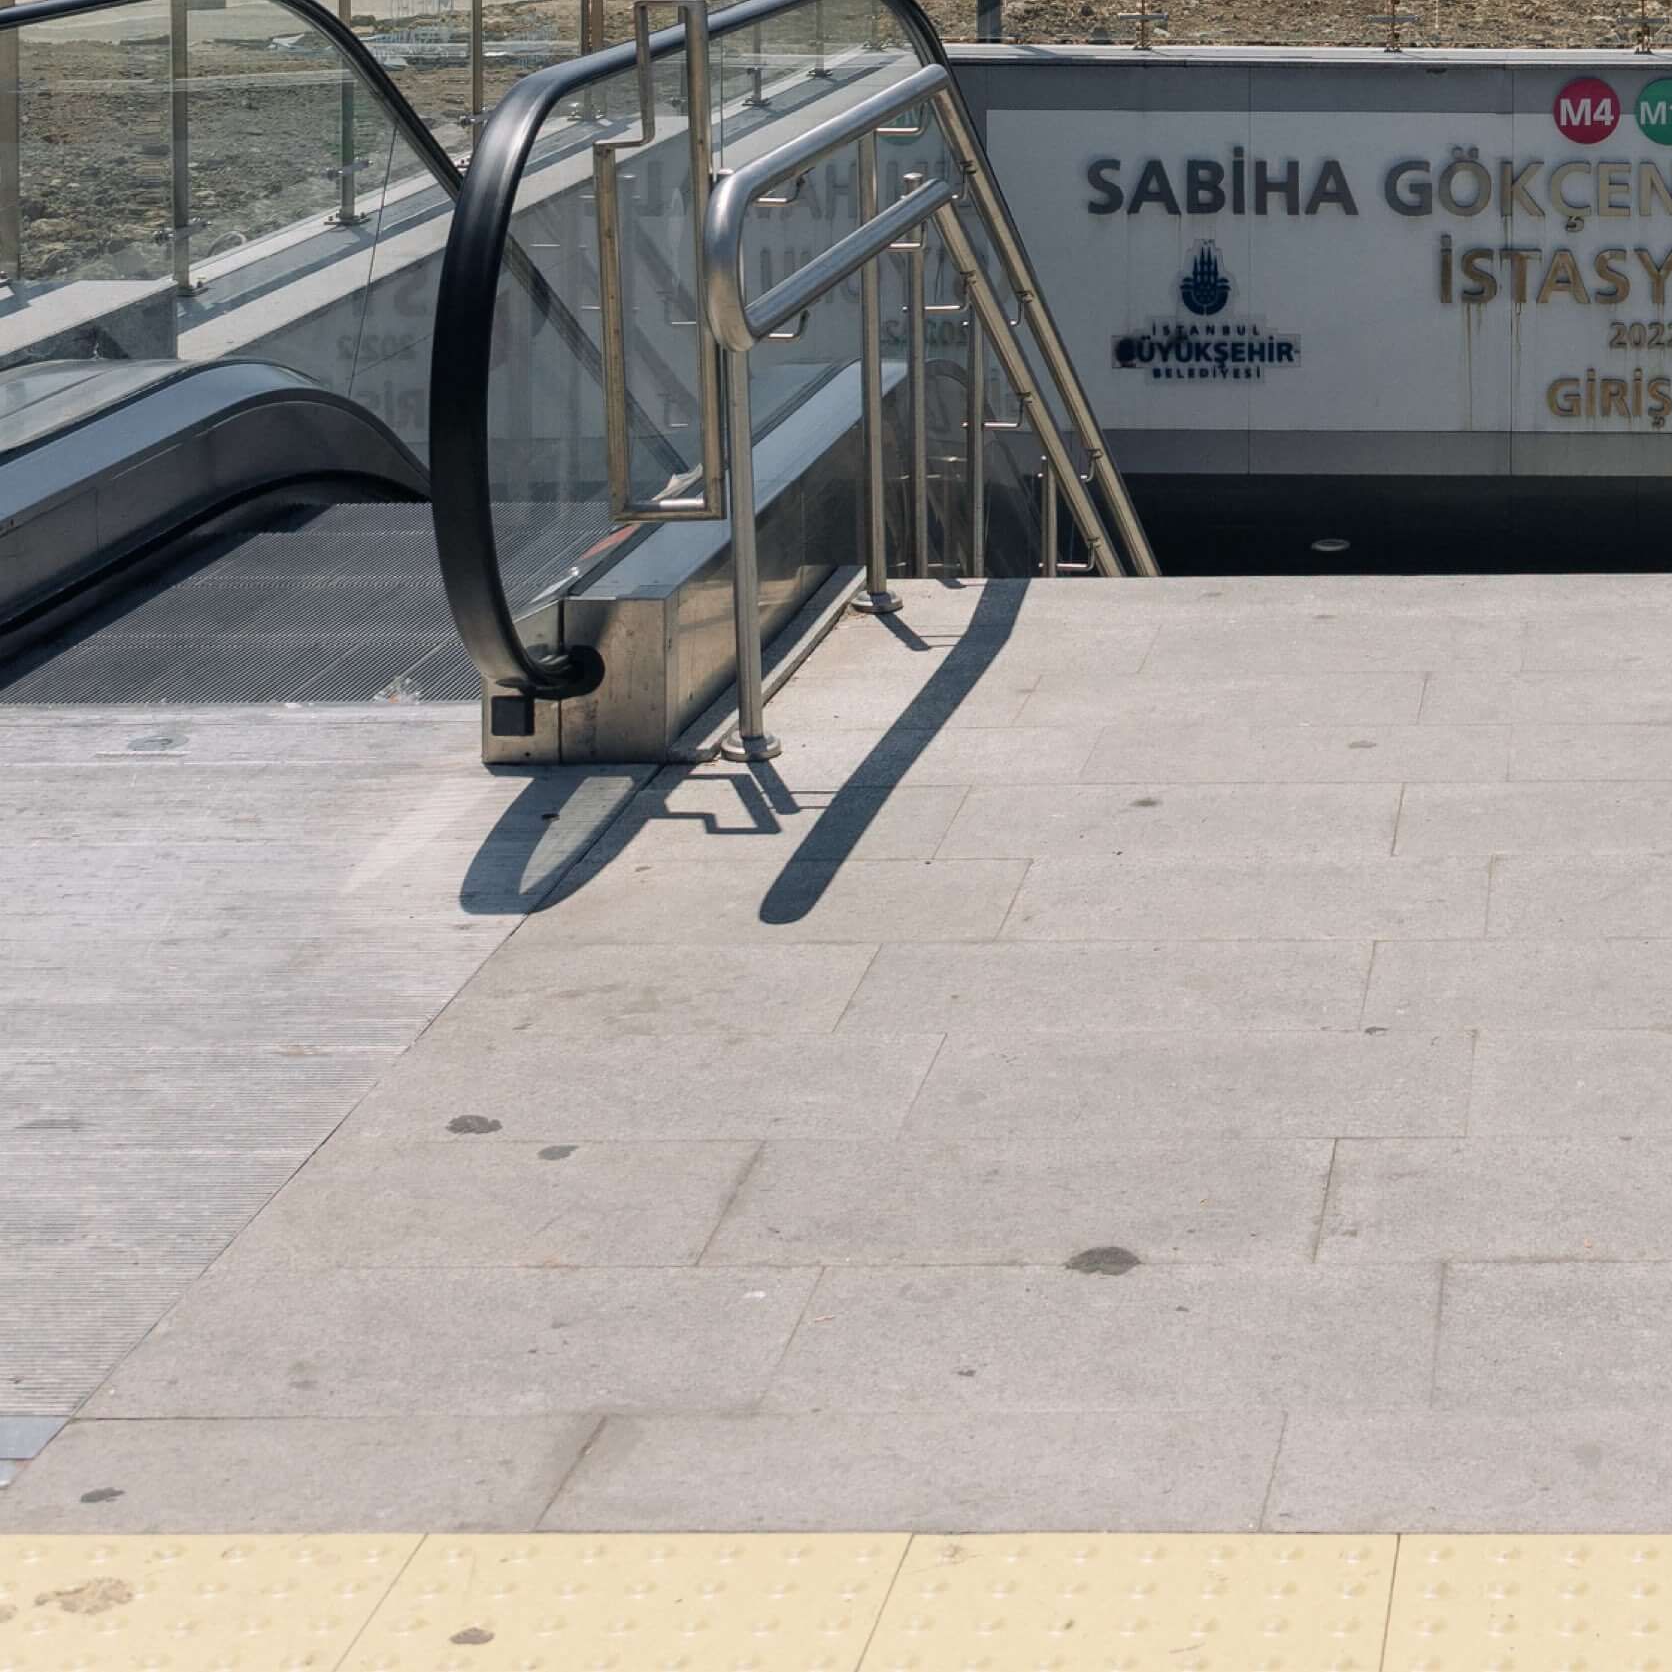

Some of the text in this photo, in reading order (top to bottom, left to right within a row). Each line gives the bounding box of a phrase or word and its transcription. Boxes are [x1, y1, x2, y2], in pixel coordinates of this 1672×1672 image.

[1559, 97, 1616, 127] M4
[1086, 145, 1360, 217] SABİHA
[1152, 322, 1261, 336] İSTANBUL
[1116, 335, 1295, 369] ÜYÜKŞEHİR
[1152, 366, 1261, 379] BELEDİYESİ
